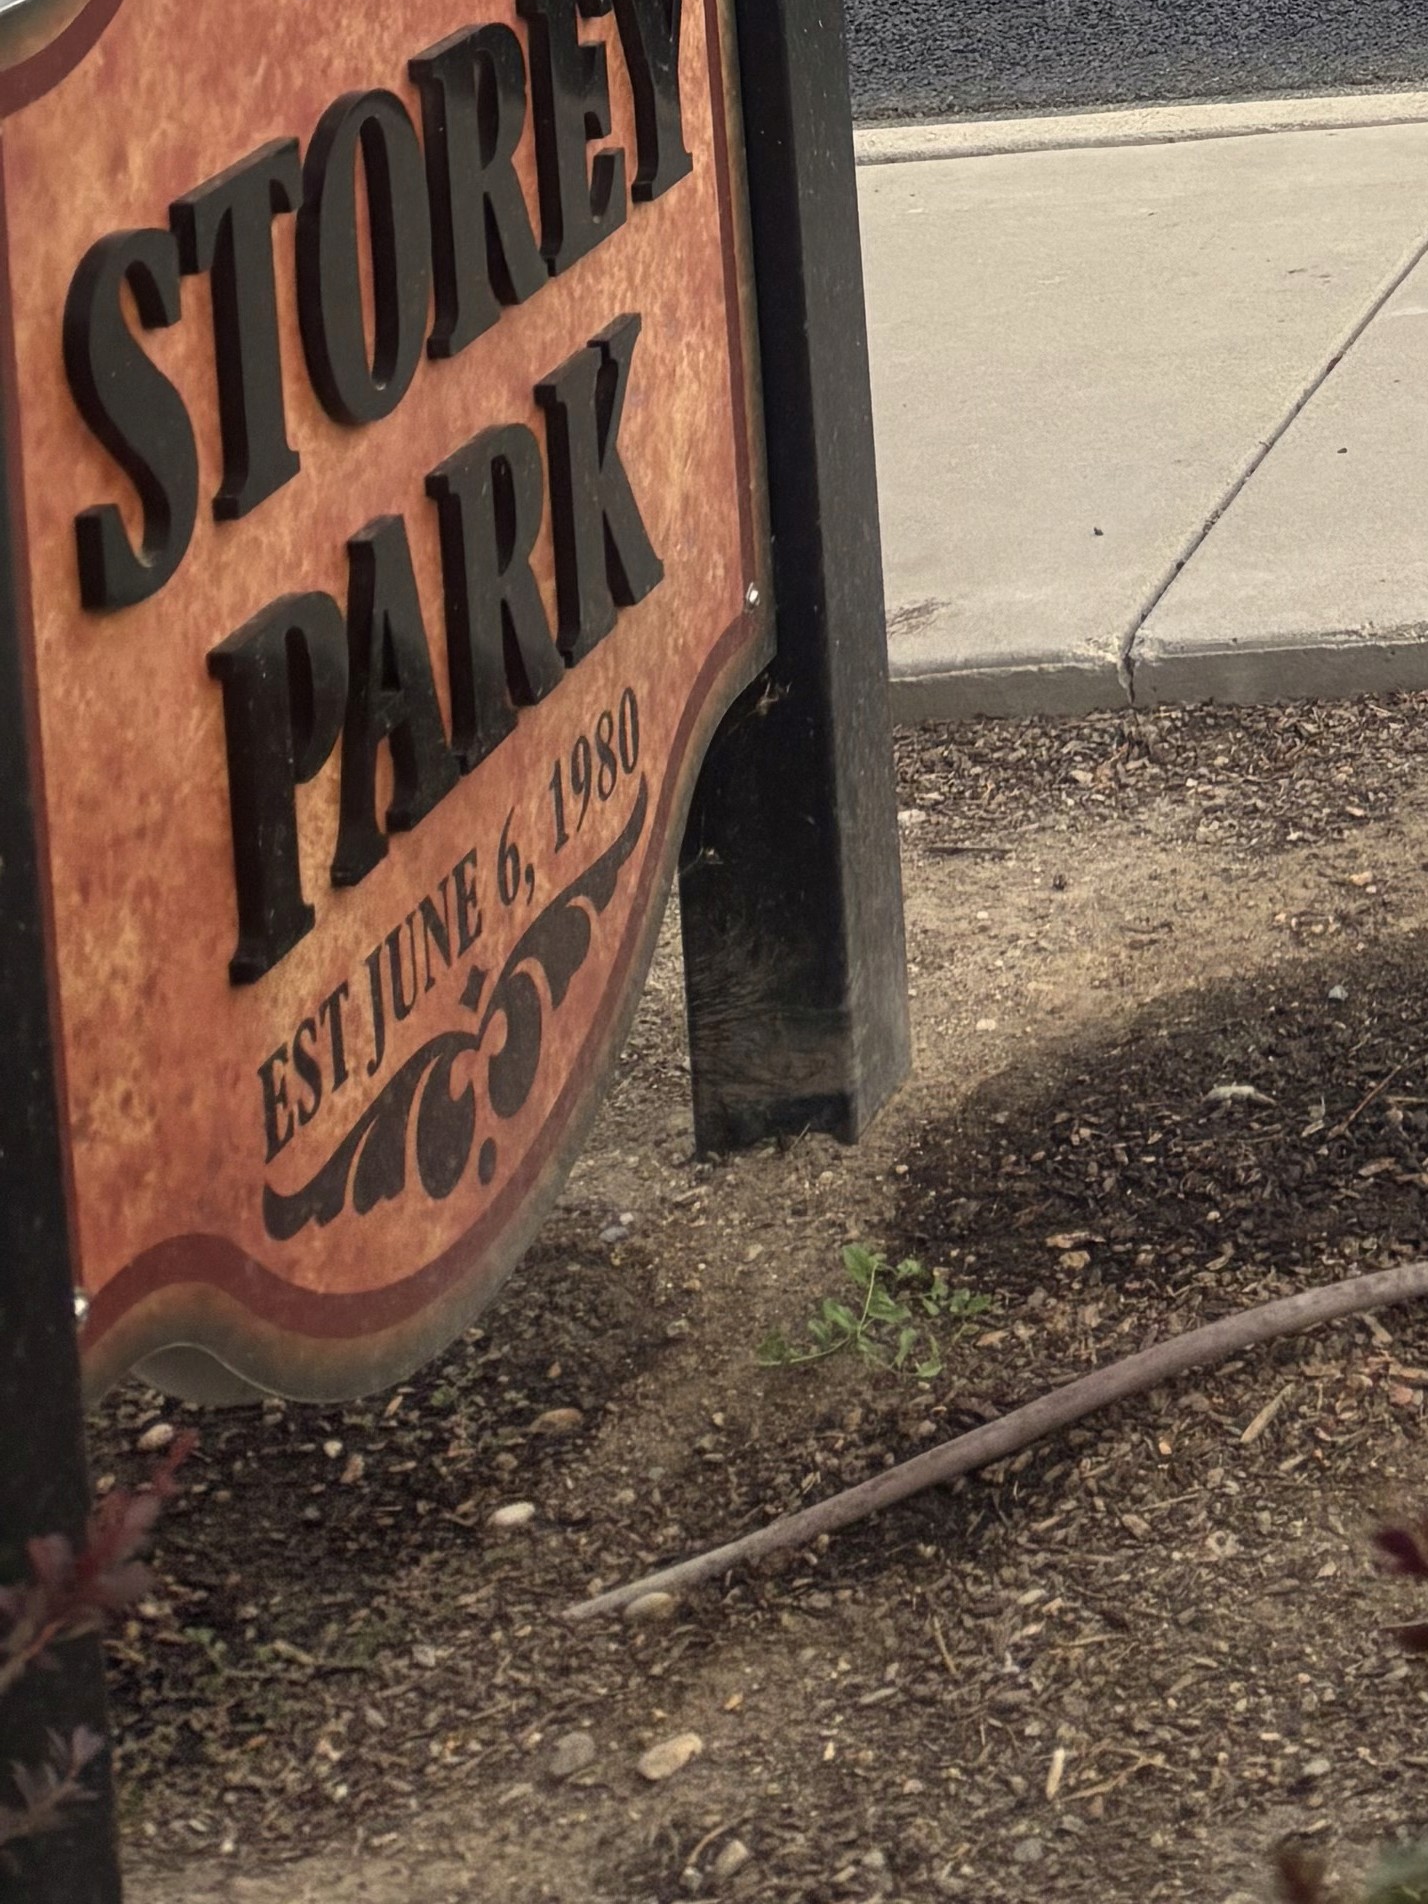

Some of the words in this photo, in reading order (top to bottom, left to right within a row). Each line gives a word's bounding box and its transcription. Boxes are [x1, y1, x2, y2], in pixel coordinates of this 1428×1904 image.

[205, 313, 665, 986] PARK
[364, 847, 483, 1078] JUNE
[497, 805, 536, 906] 6,
[548, 686, 641, 853] 1980
